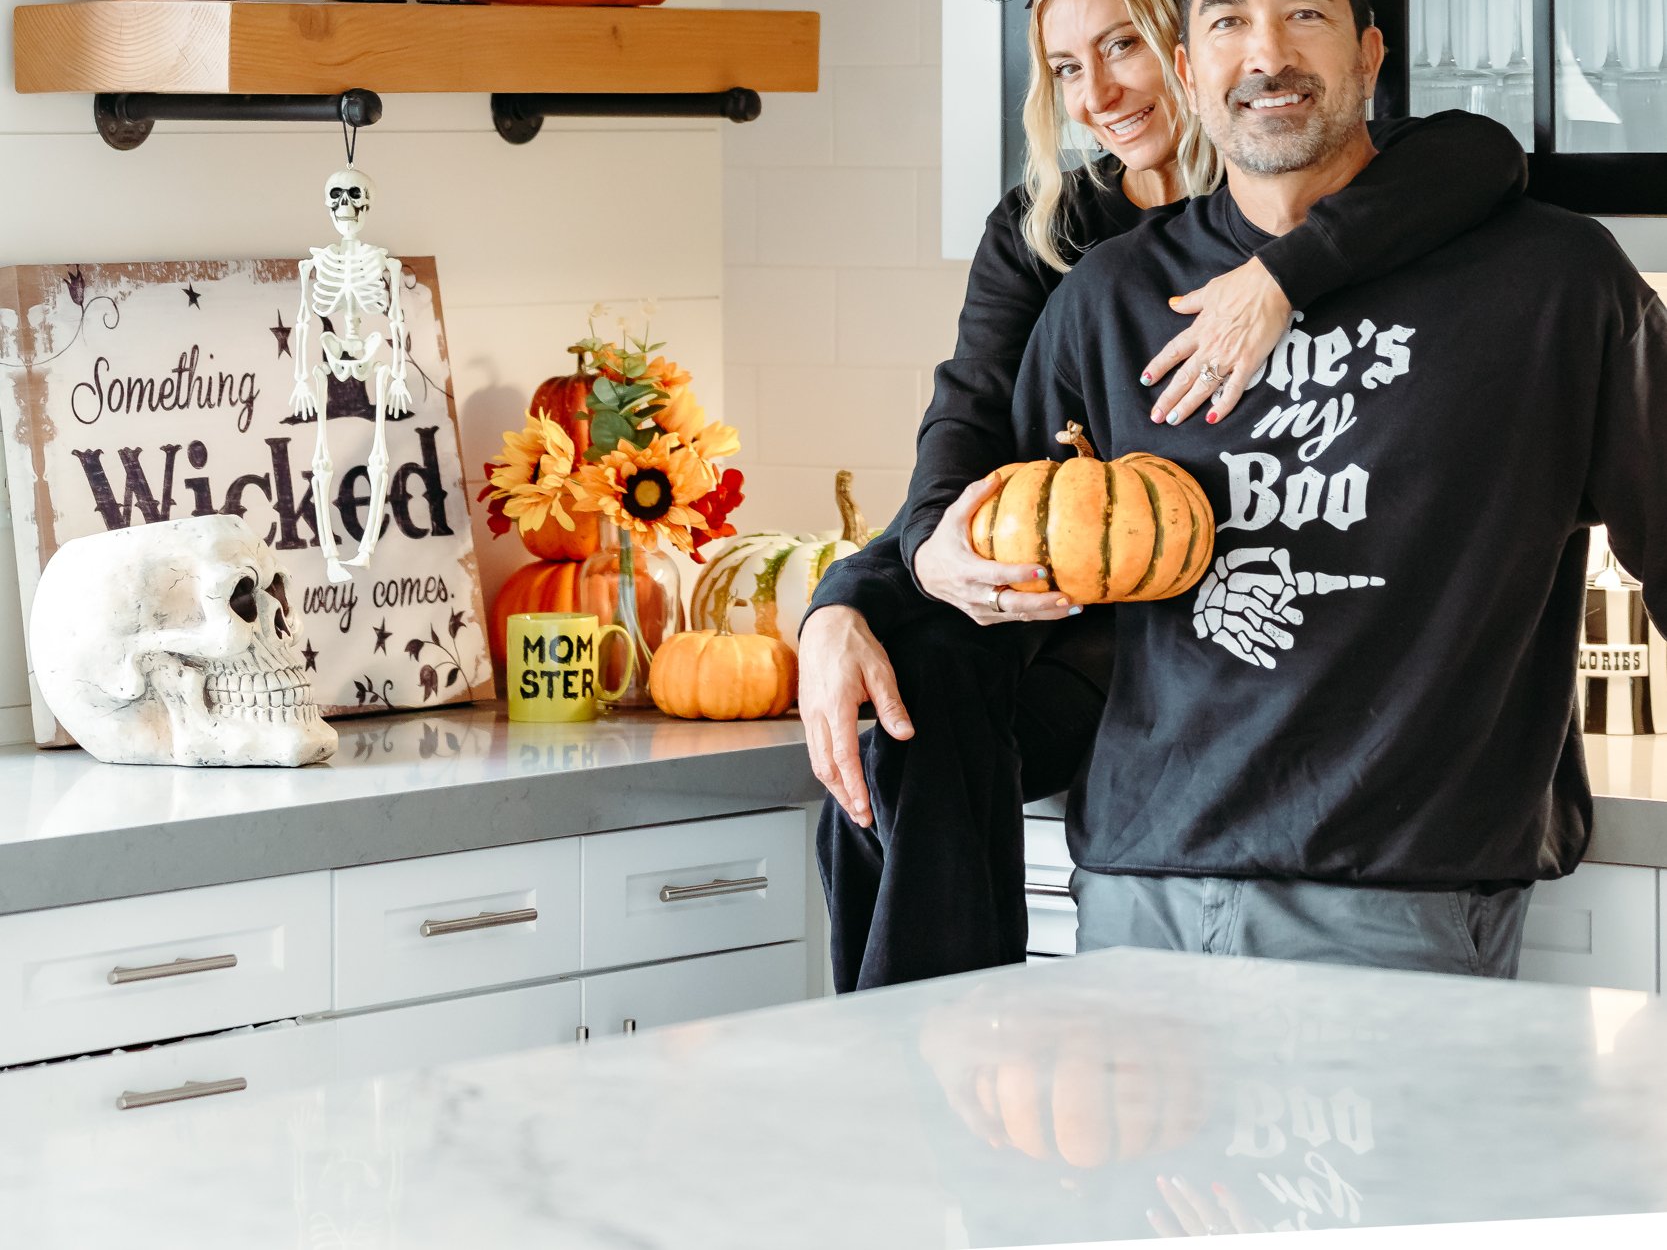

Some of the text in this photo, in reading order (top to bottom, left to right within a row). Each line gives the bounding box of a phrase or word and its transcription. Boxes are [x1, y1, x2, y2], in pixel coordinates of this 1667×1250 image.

[71, 344, 260, 433] Something
[1211, 310, 1416, 405] he's
[1251, 393, 1357, 462] my
[1216, 451, 1370, 534] Boo
[303, 575, 454, 633] way comes.
[520, 668, 594, 701] STER
[523, 634, 593, 666] MOM
